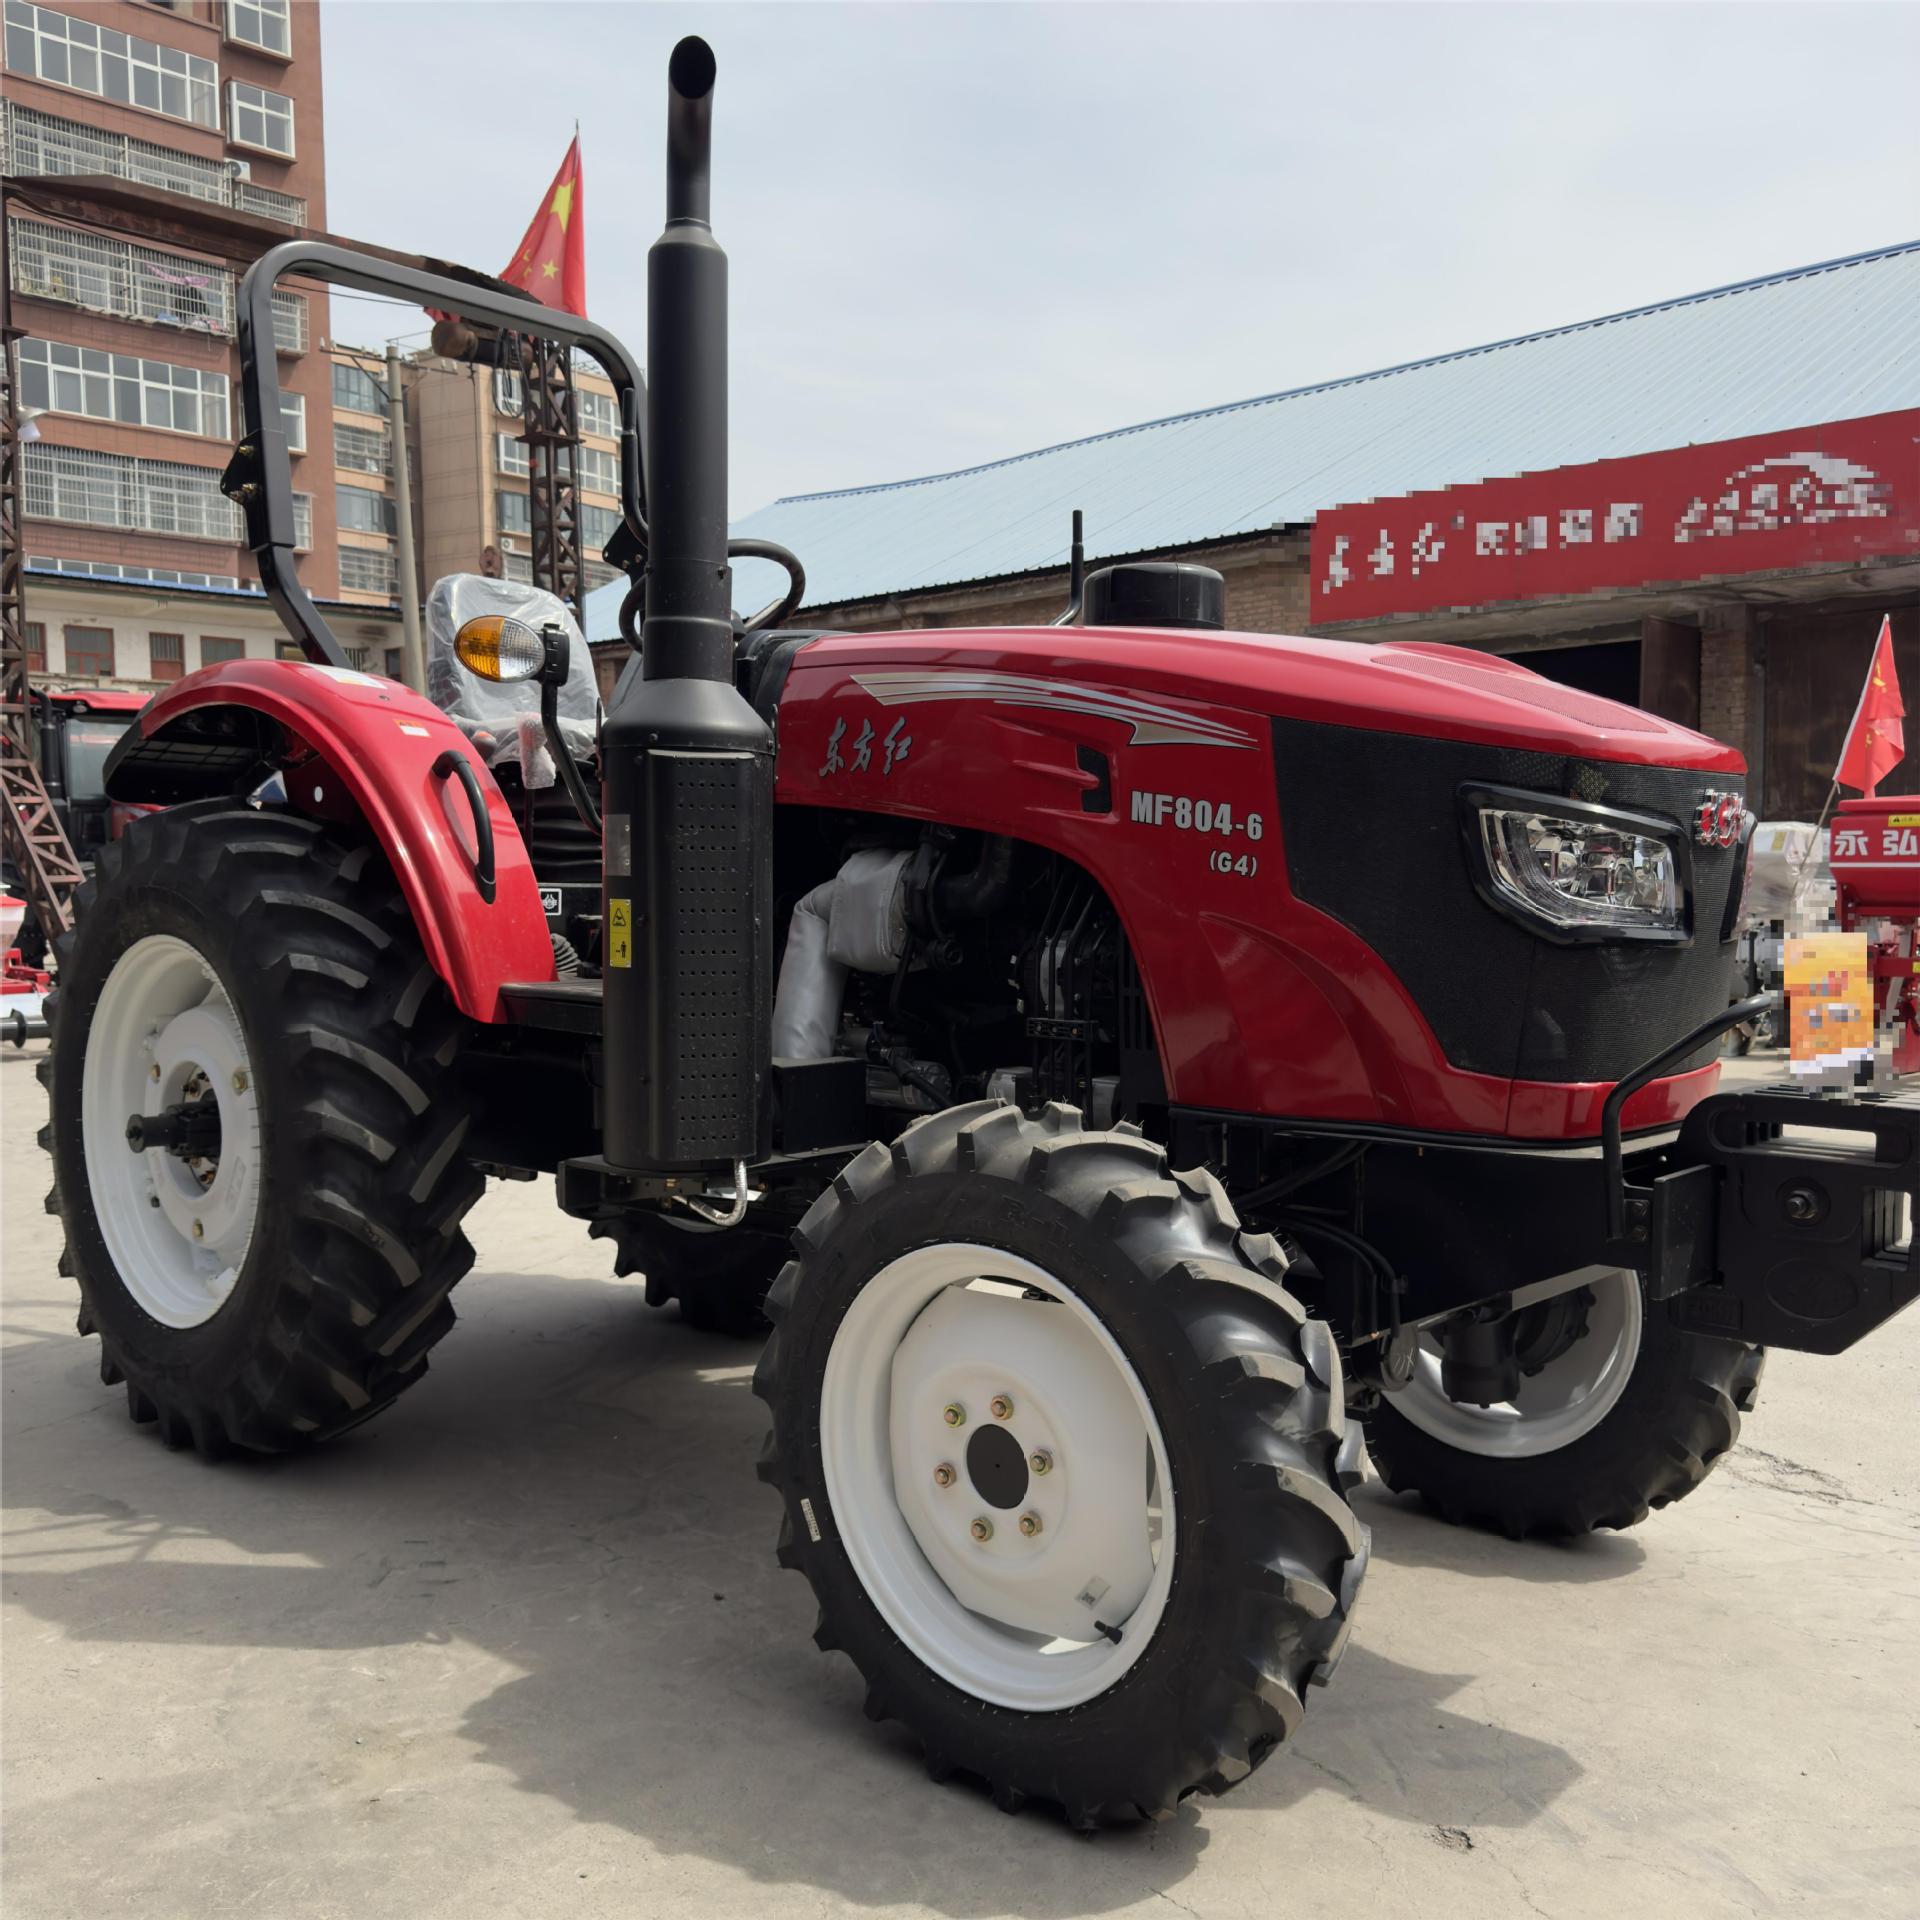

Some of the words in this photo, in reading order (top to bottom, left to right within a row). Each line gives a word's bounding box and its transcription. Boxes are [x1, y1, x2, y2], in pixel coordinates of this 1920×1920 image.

[818, 716, 913, 777] 东方红
[1131, 790, 1263, 840] MF804-6
[1209, 849, 1258, 877] (G4)
